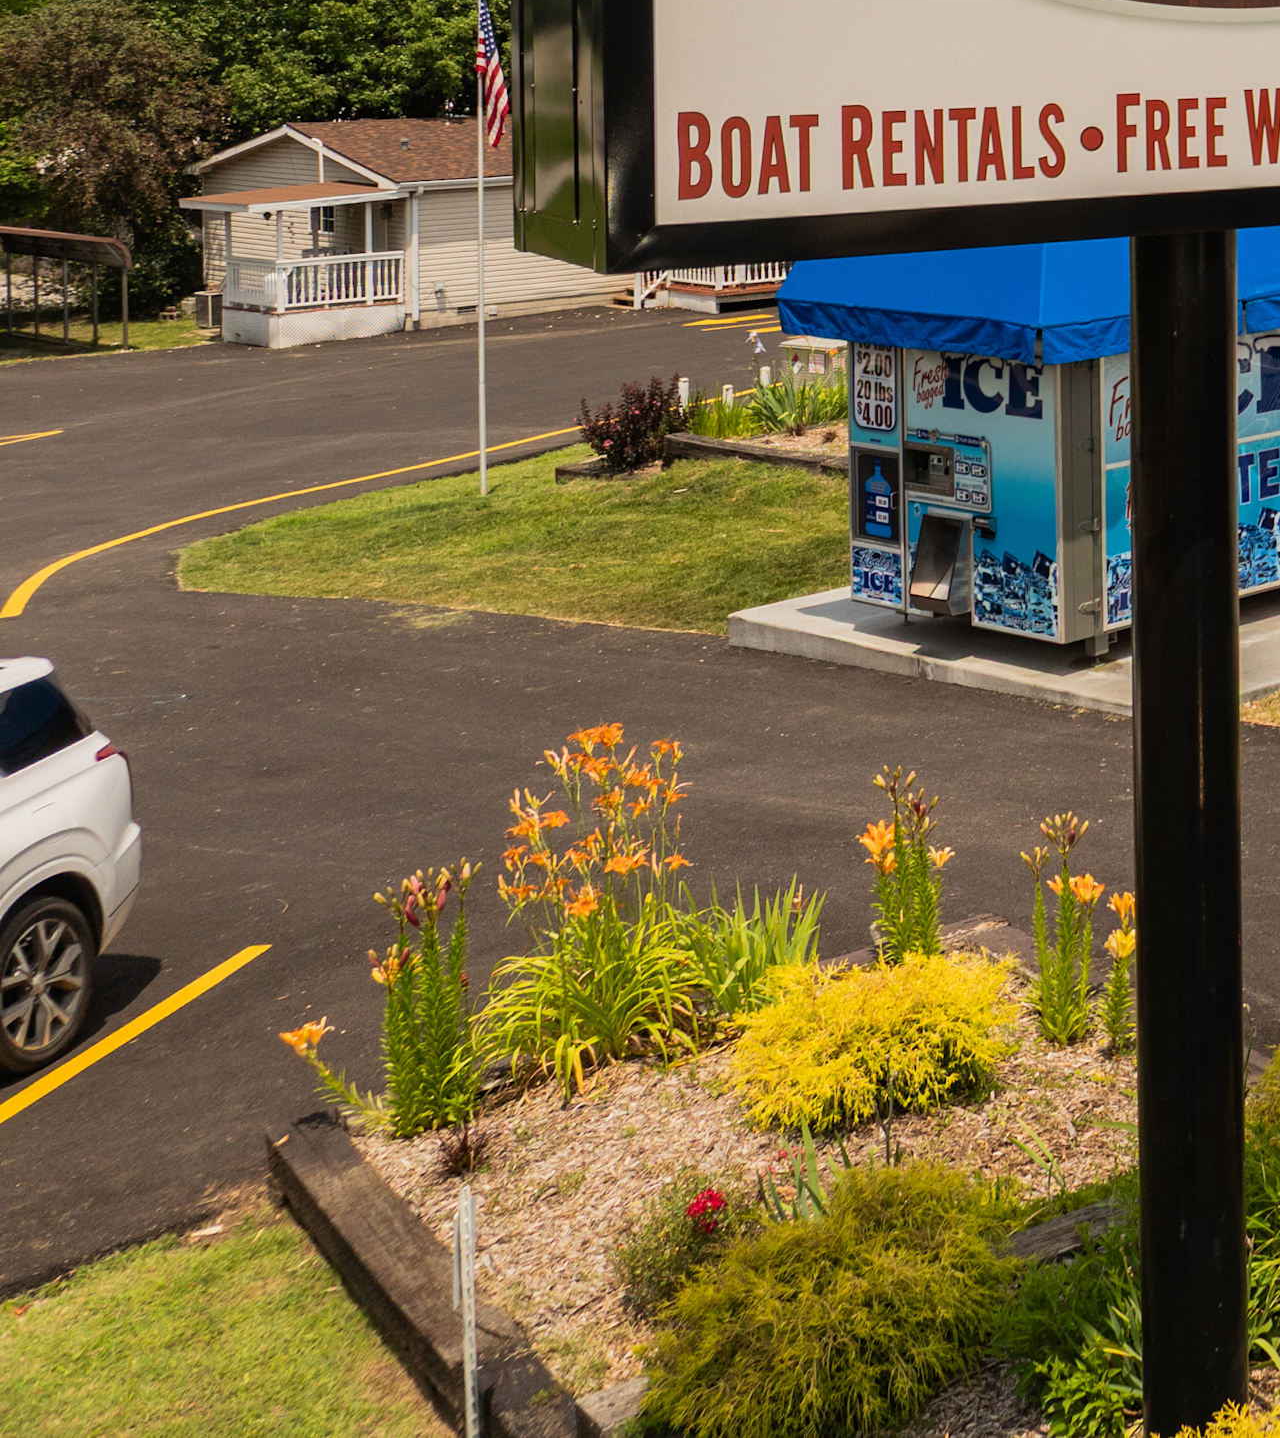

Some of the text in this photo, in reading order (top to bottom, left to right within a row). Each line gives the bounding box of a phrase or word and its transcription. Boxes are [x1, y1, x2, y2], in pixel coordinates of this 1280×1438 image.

[677, 111, 820, 200] BOAT
[841, 103, 1065, 189] RENTALS
[1116, 92, 1228, 173] FREE
[856, 350, 892, 378] $2.00
[857, 380, 893, 403] 20 lbs
[943, 351, 1044, 420] ICE
[857, 402, 893, 429] $4.00
[862, 568, 895, 594] ICE
